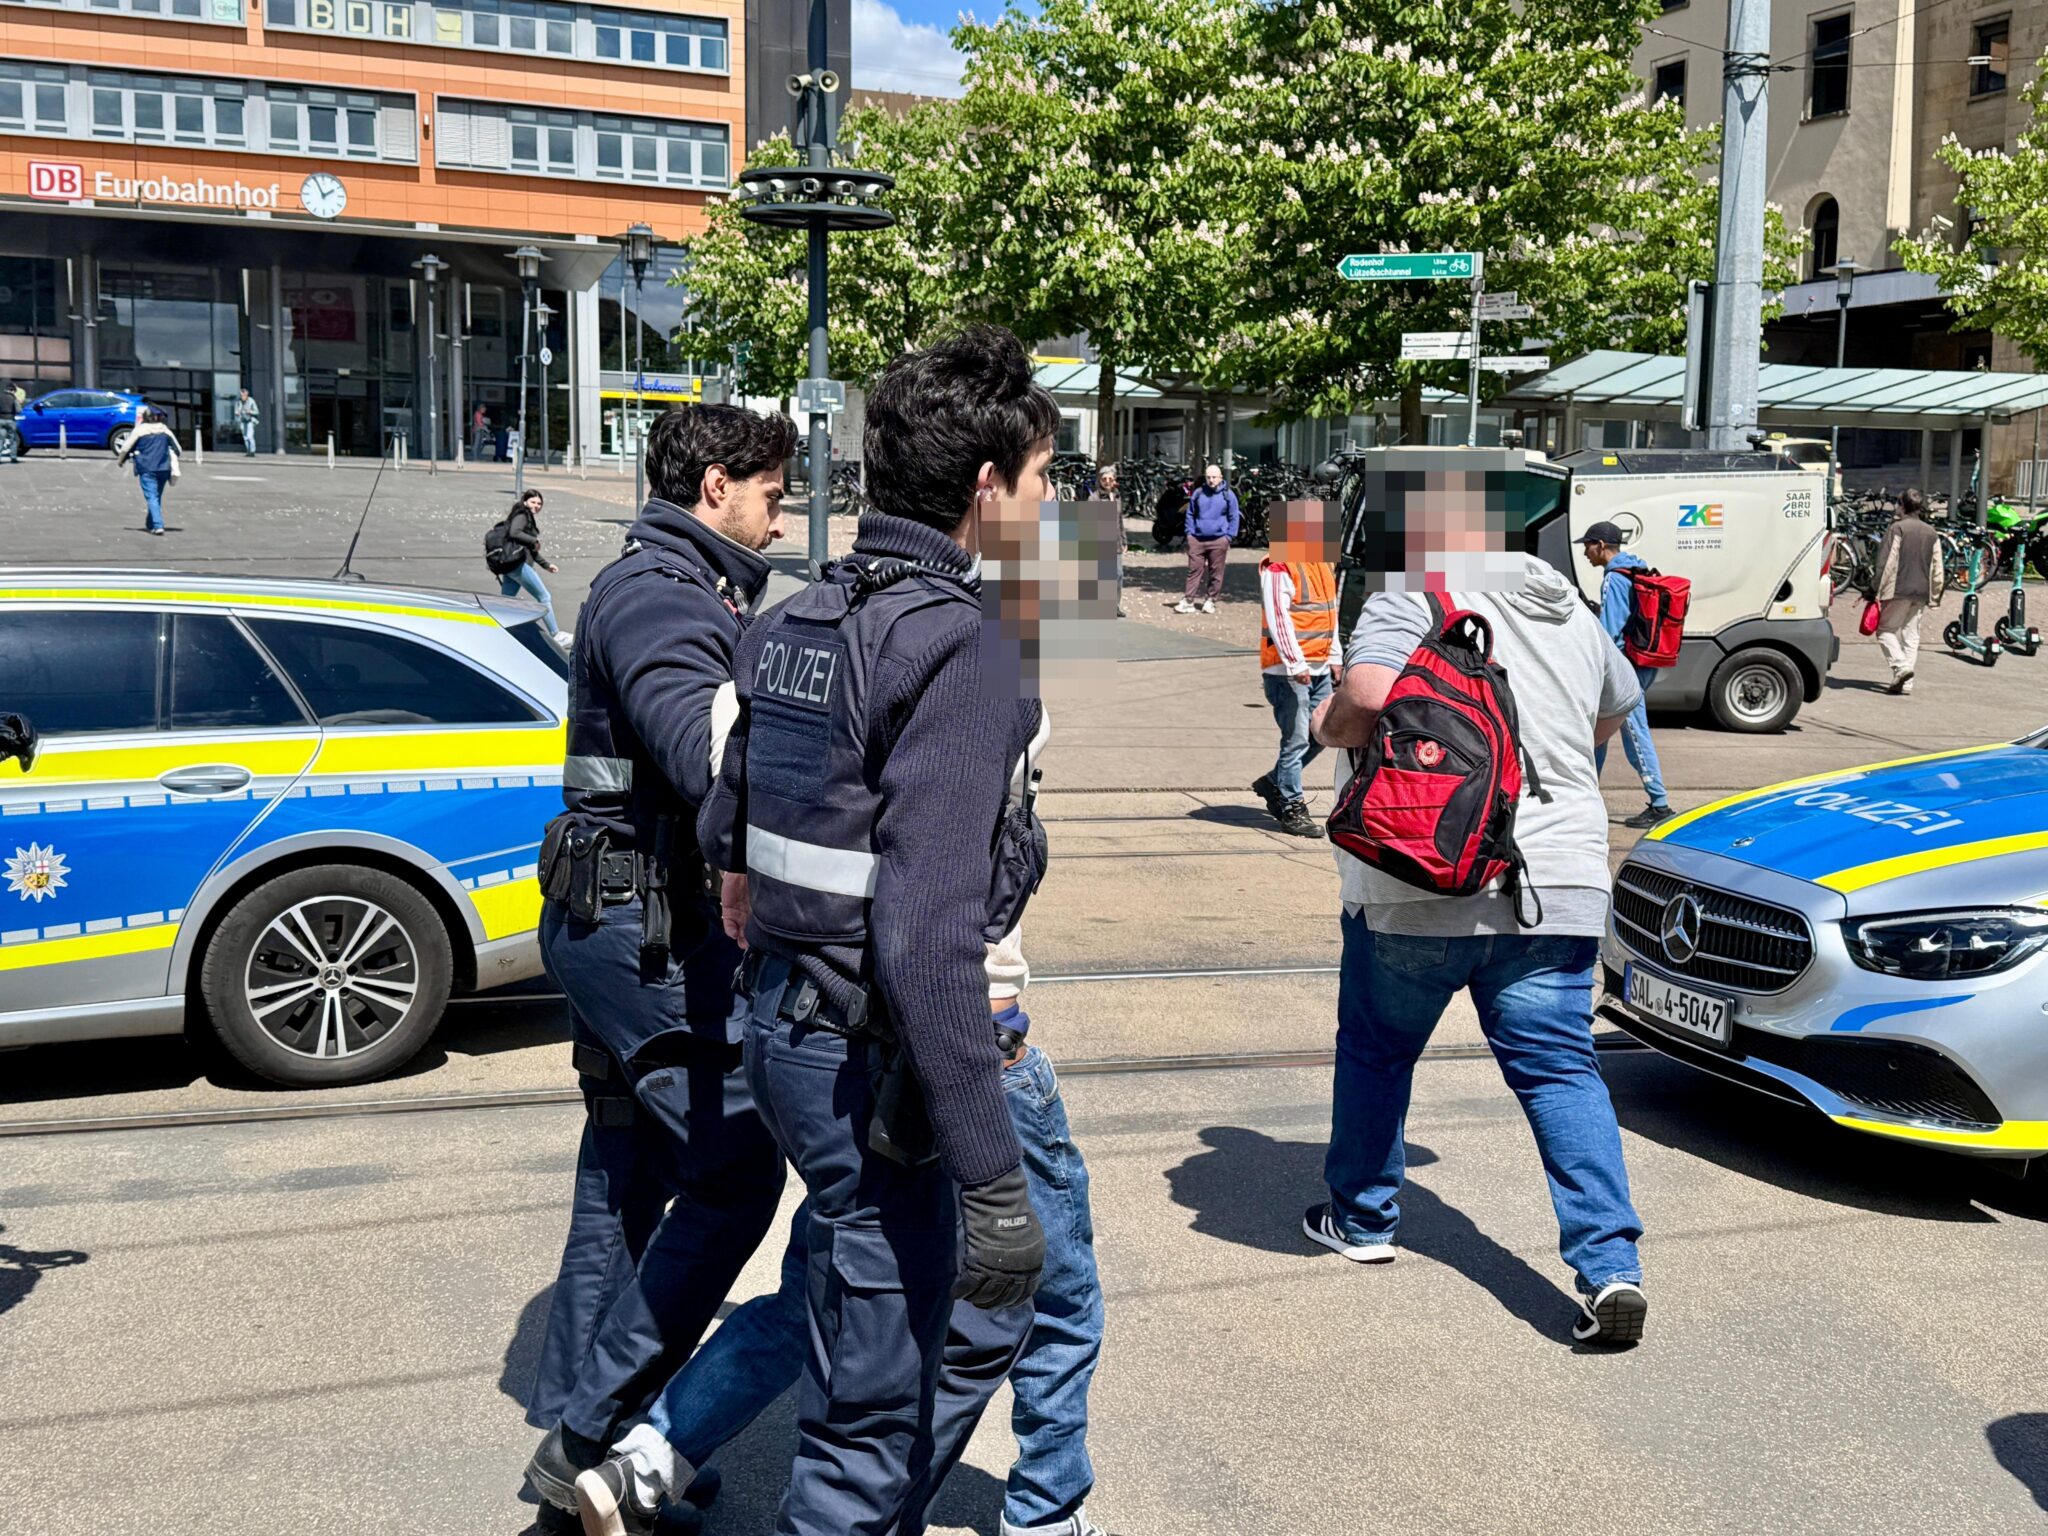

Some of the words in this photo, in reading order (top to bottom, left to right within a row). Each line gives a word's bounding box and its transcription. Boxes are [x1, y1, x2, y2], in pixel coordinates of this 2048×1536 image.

[311, 0, 409, 37] BDH
[35, 167, 77, 193] DB
[94, 170, 280, 208] Eurobahnhof
[1349, 257, 1385, 267] Rodenhof
[1785, 492, 1811, 501] SAAR
[1678, 504, 1723, 527] ZKE
[1785, 510, 1811, 518] CKEN
[754, 641, 837, 704] POLIZEI
[1630, 972, 1654, 1010] SAL
[1664, 987, 1724, 1034] 4-5047
[997, 1215, 1027, 1228] POLIZEI
